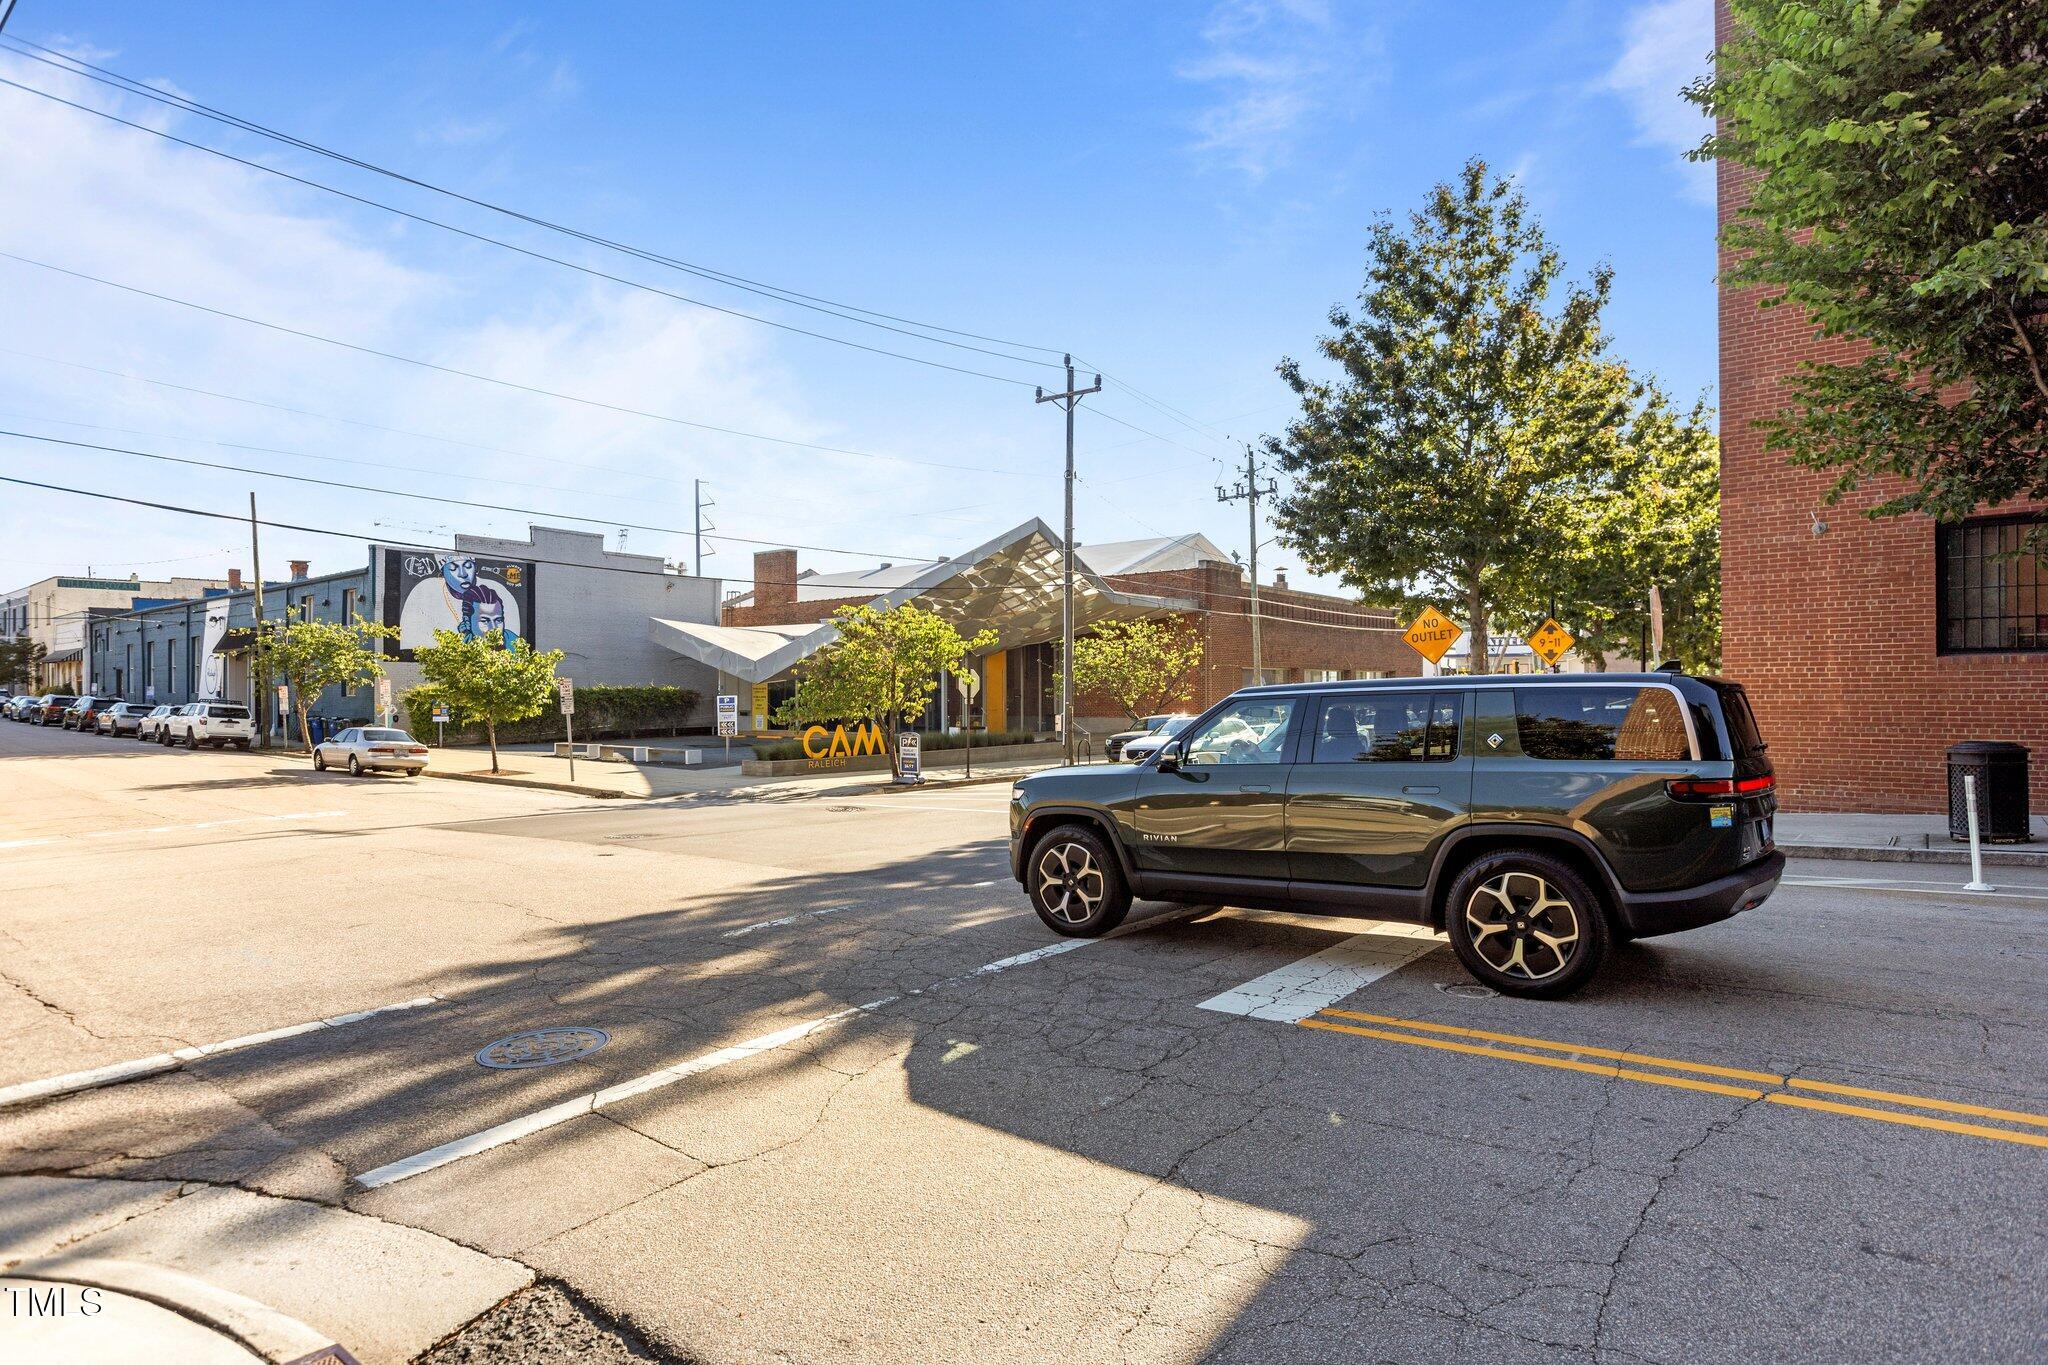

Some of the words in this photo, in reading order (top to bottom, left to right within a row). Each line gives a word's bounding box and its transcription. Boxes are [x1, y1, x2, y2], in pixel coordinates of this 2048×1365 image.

[1423, 618, 1439, 629] NO
[1411, 629, 1453, 643] OUTLET
[803, 724, 886, 759] CAM
[902, 738, 908, 747] P
[1143, 834, 1178, 842] RIVIAN
